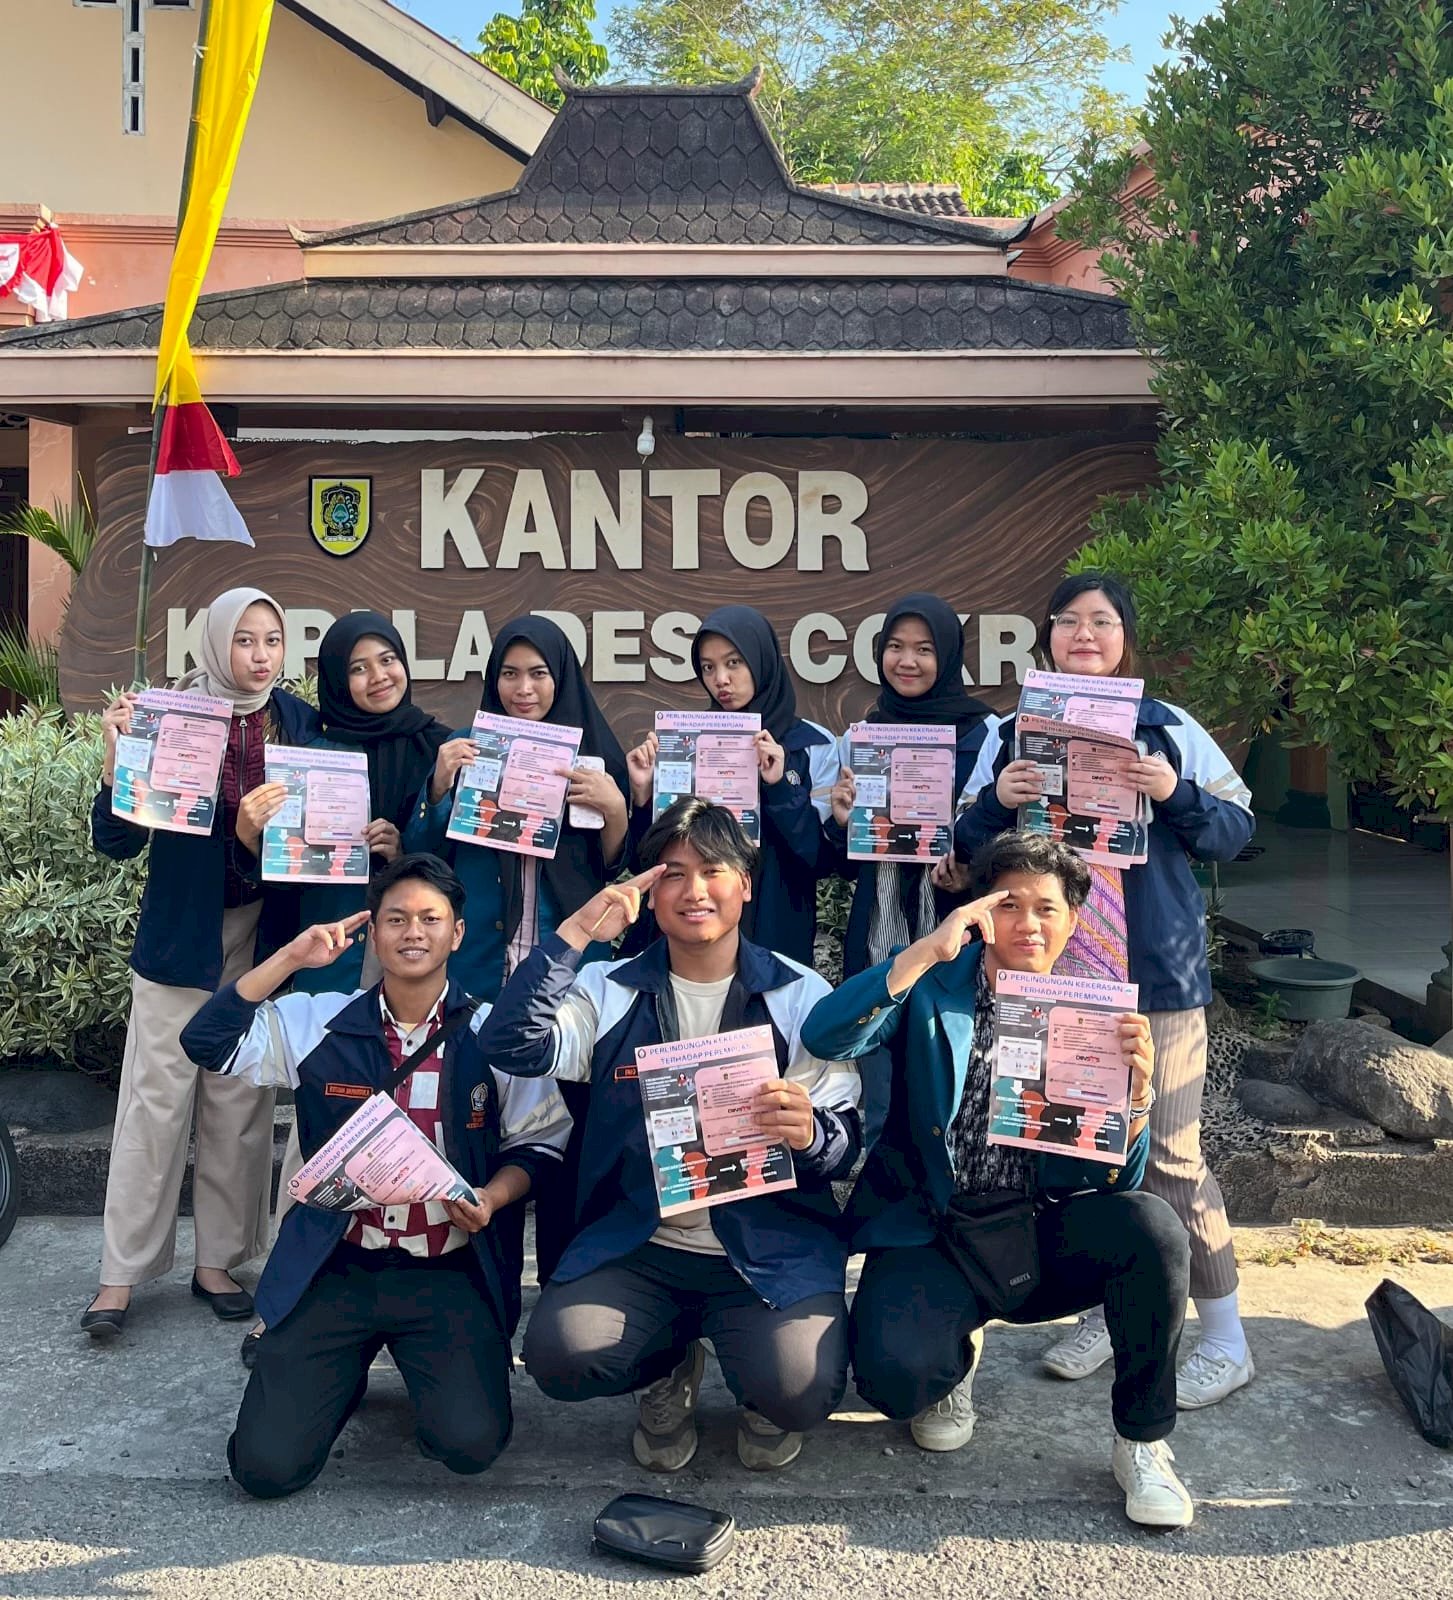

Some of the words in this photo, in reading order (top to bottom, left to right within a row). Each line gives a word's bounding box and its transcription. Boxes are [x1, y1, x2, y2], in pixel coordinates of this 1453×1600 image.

[420, 468, 870, 571] KANTOR
[166, 608, 492, 681] KPLA
[901, 734, 938, 742] PEREMPUAN
[1010, 972, 1074, 987] PERLINDUNGAN
[1075, 980, 1123, 992] KEKERASAN
[1020, 984, 1062, 996] TERHADAP
[1063, 990, 1112, 1002] PEREMPUAN
[649, 1039, 711, 1055] PERLINDUNGAN
[660, 1051, 703, 1064] TERHADAP
[296, 1135, 344, 1181] PERLINDUNGAN
[341, 1102, 378, 1137] KEKERASAN
[311, 1150, 343, 1181] TERHADAP
[340, 1116, 379, 1153] PEREMPUAN
